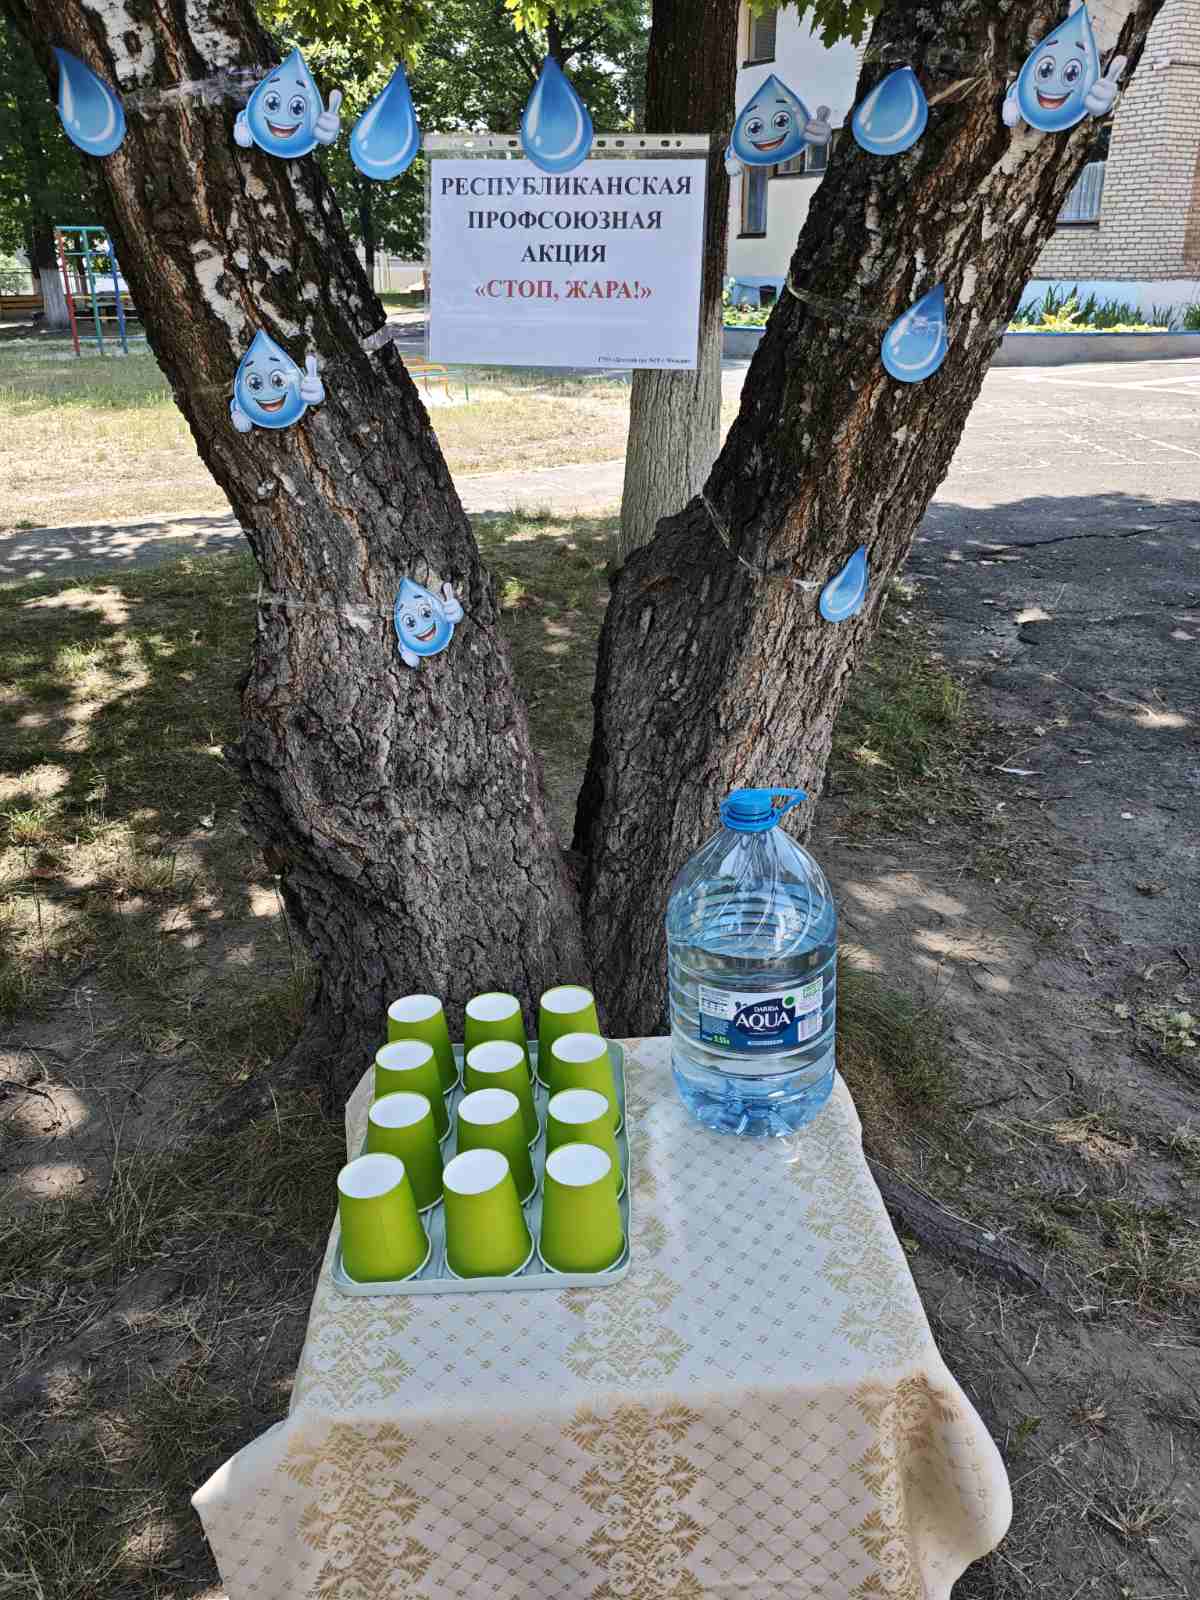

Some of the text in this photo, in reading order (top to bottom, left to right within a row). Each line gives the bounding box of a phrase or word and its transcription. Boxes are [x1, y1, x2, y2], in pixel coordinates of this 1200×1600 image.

[441, 177, 691, 195] РЕСПУБЛИКАНСКАЯ
[468, 211, 663, 229] ПРОФСОЮЗНАЯ
[521, 245, 606, 265] АКЦИЯ
[475, 279, 652, 301] «СТОП, ЖАРА!»
[736, 1012, 791, 1031] AQUA
